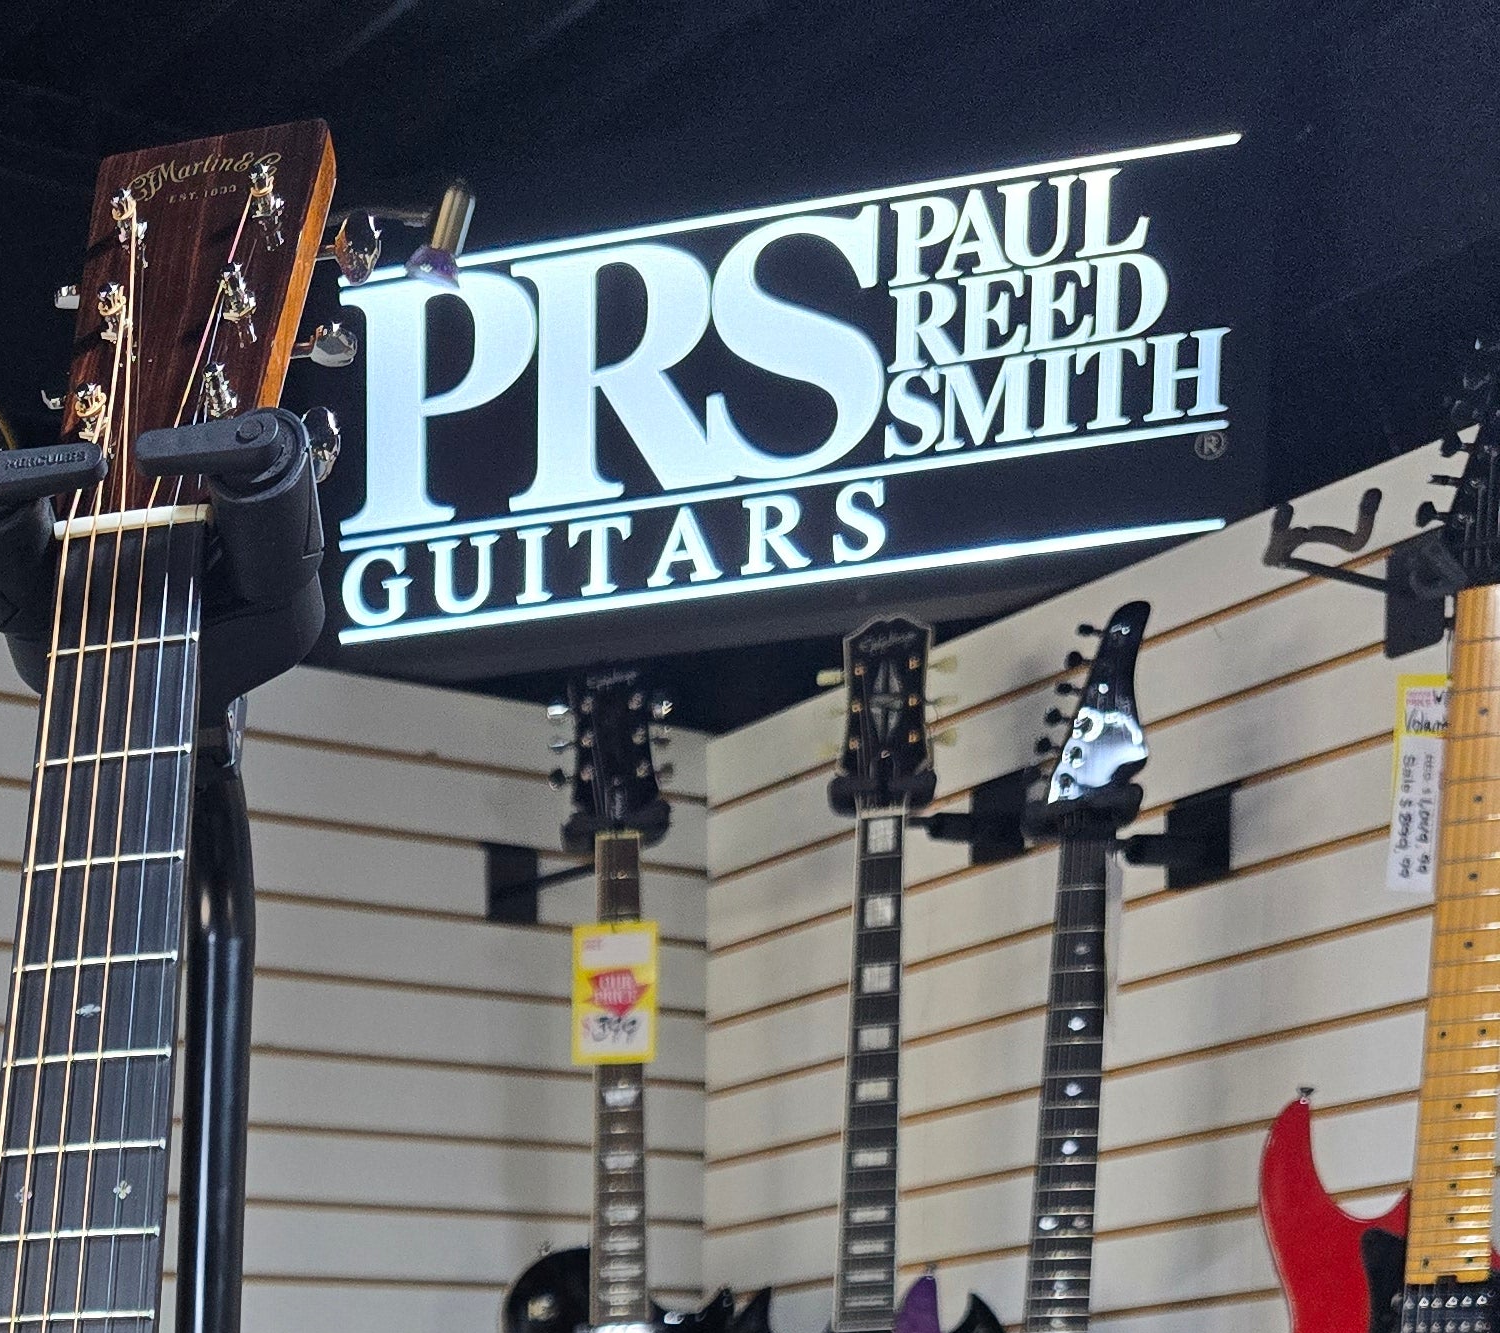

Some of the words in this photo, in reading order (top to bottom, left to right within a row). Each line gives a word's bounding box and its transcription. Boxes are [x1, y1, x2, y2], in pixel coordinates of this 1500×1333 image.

[340, 205, 886, 534] PRS
[887, 168, 1148, 289] PAUL
[887, 252, 1169, 373] REED
[884, 326, 1233, 461] SMITH
[340, 479, 888, 627] GUITARS
